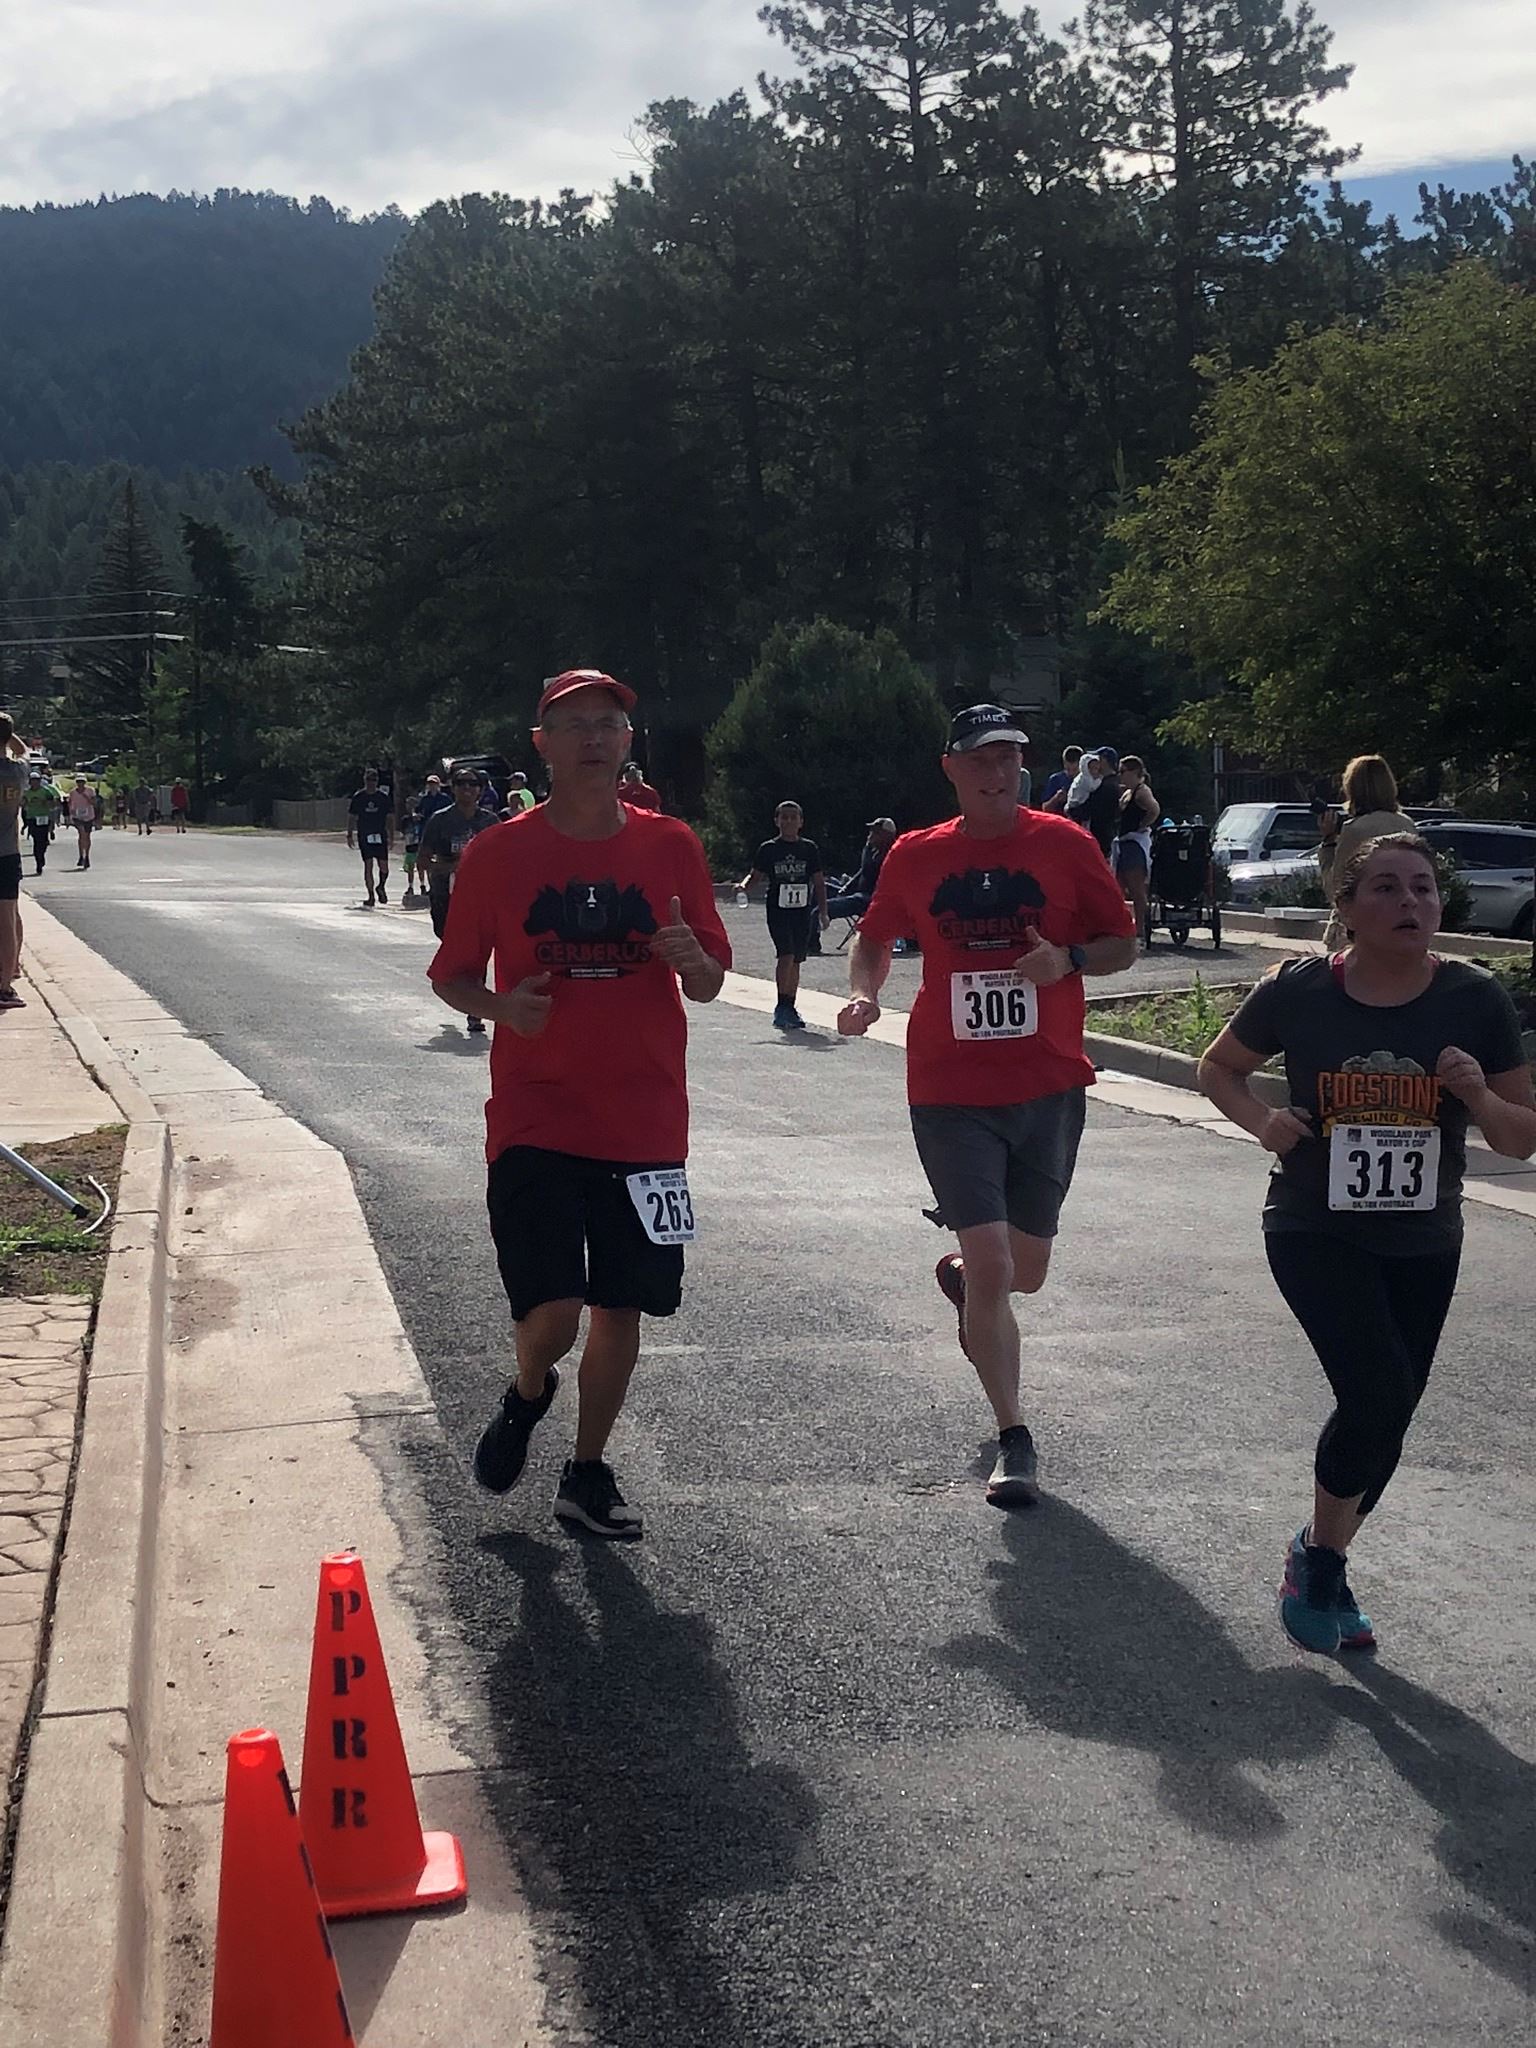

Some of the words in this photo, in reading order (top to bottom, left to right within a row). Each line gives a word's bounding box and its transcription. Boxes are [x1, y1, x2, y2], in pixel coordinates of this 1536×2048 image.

[969, 714, 1007, 724] TIMEX
[788, 890, 801, 904] 11
[538, 943, 650, 961] CERBERUS
[964, 988, 1026, 1029] 306
[1347, 1150, 1424, 1198] 313
[646, 1189, 695, 1233] 263
